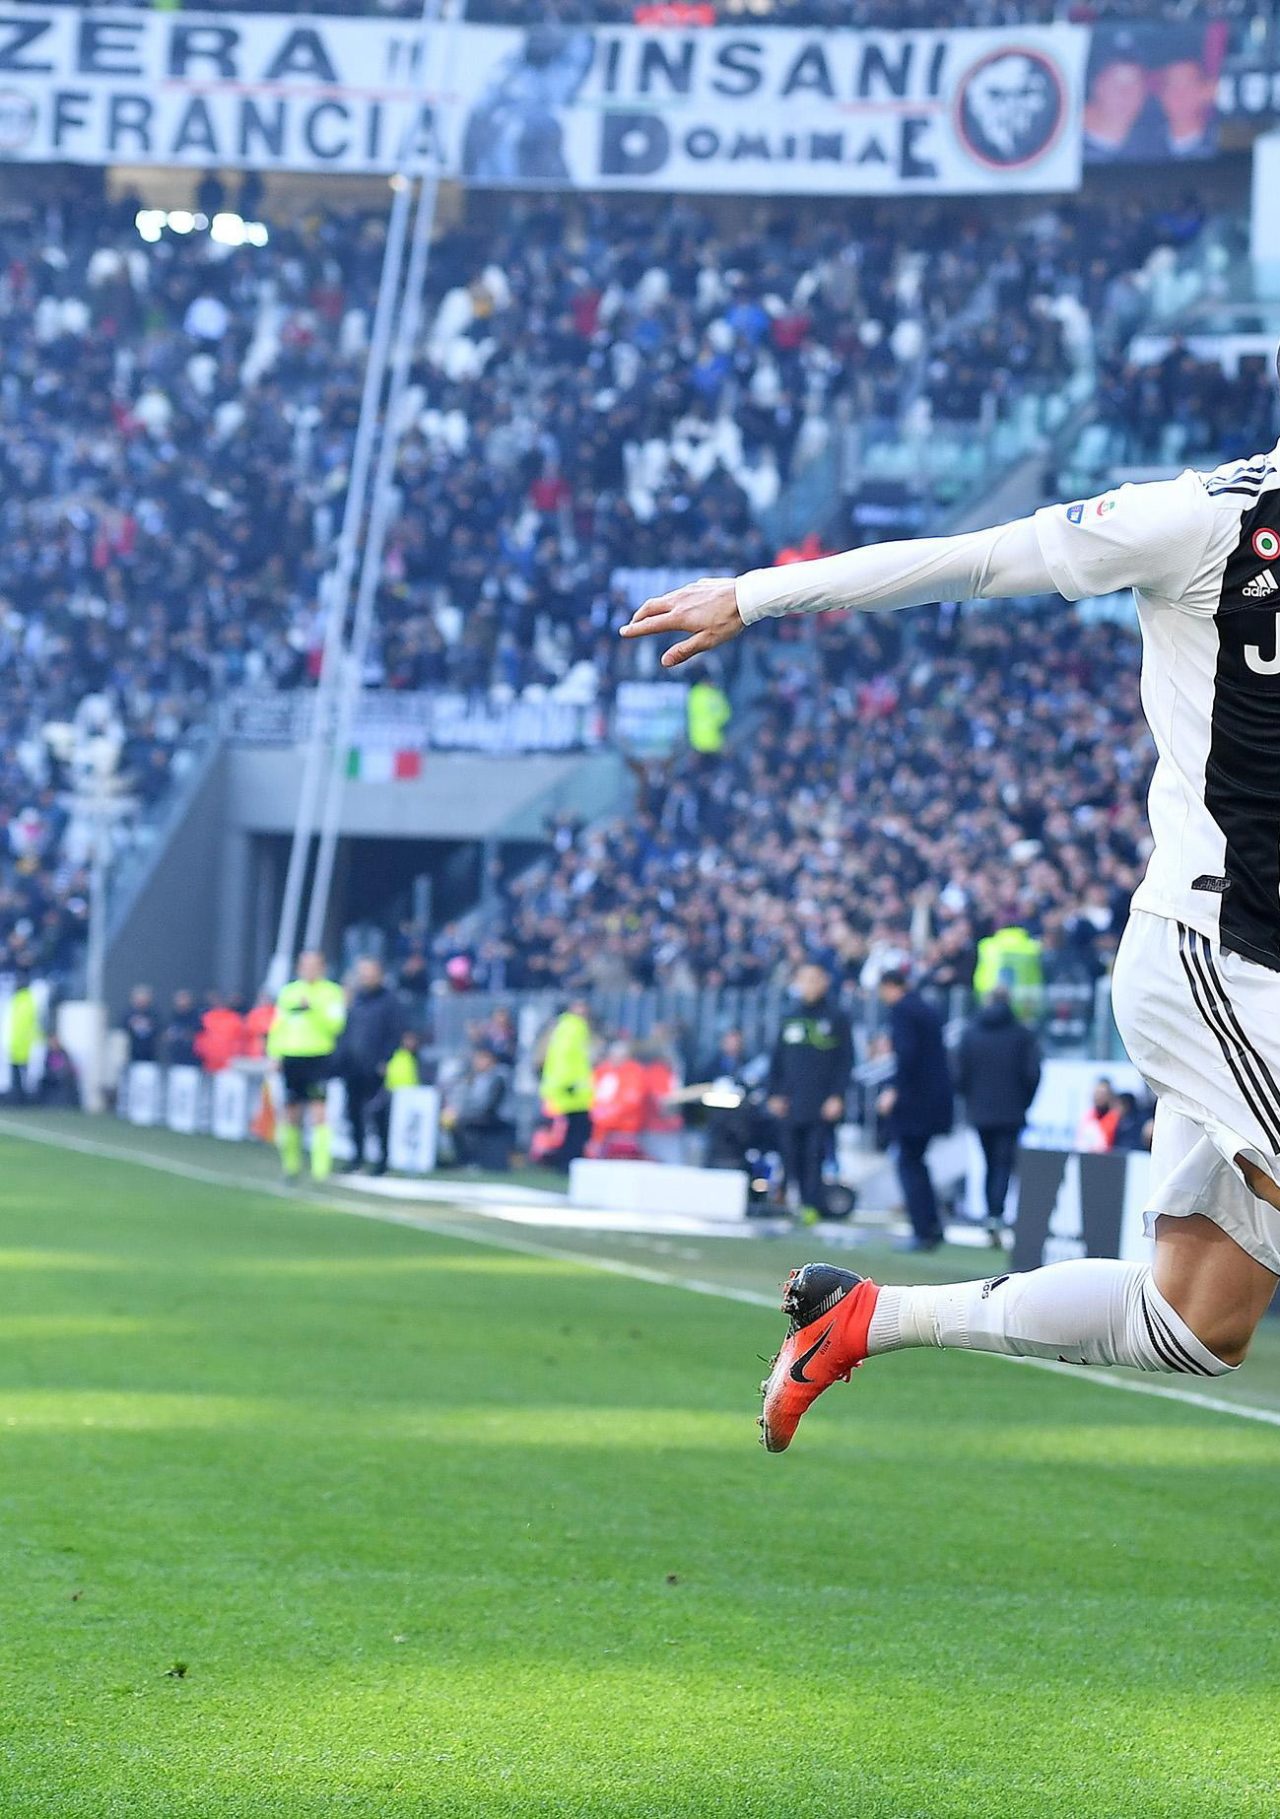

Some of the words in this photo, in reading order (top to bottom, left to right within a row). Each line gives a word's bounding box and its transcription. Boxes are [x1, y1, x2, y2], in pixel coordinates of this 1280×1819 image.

[0, 20, 338, 82] ZERA
[604, 39, 946, 98] INSANI
[52, 92, 447, 164] FRANCIA
